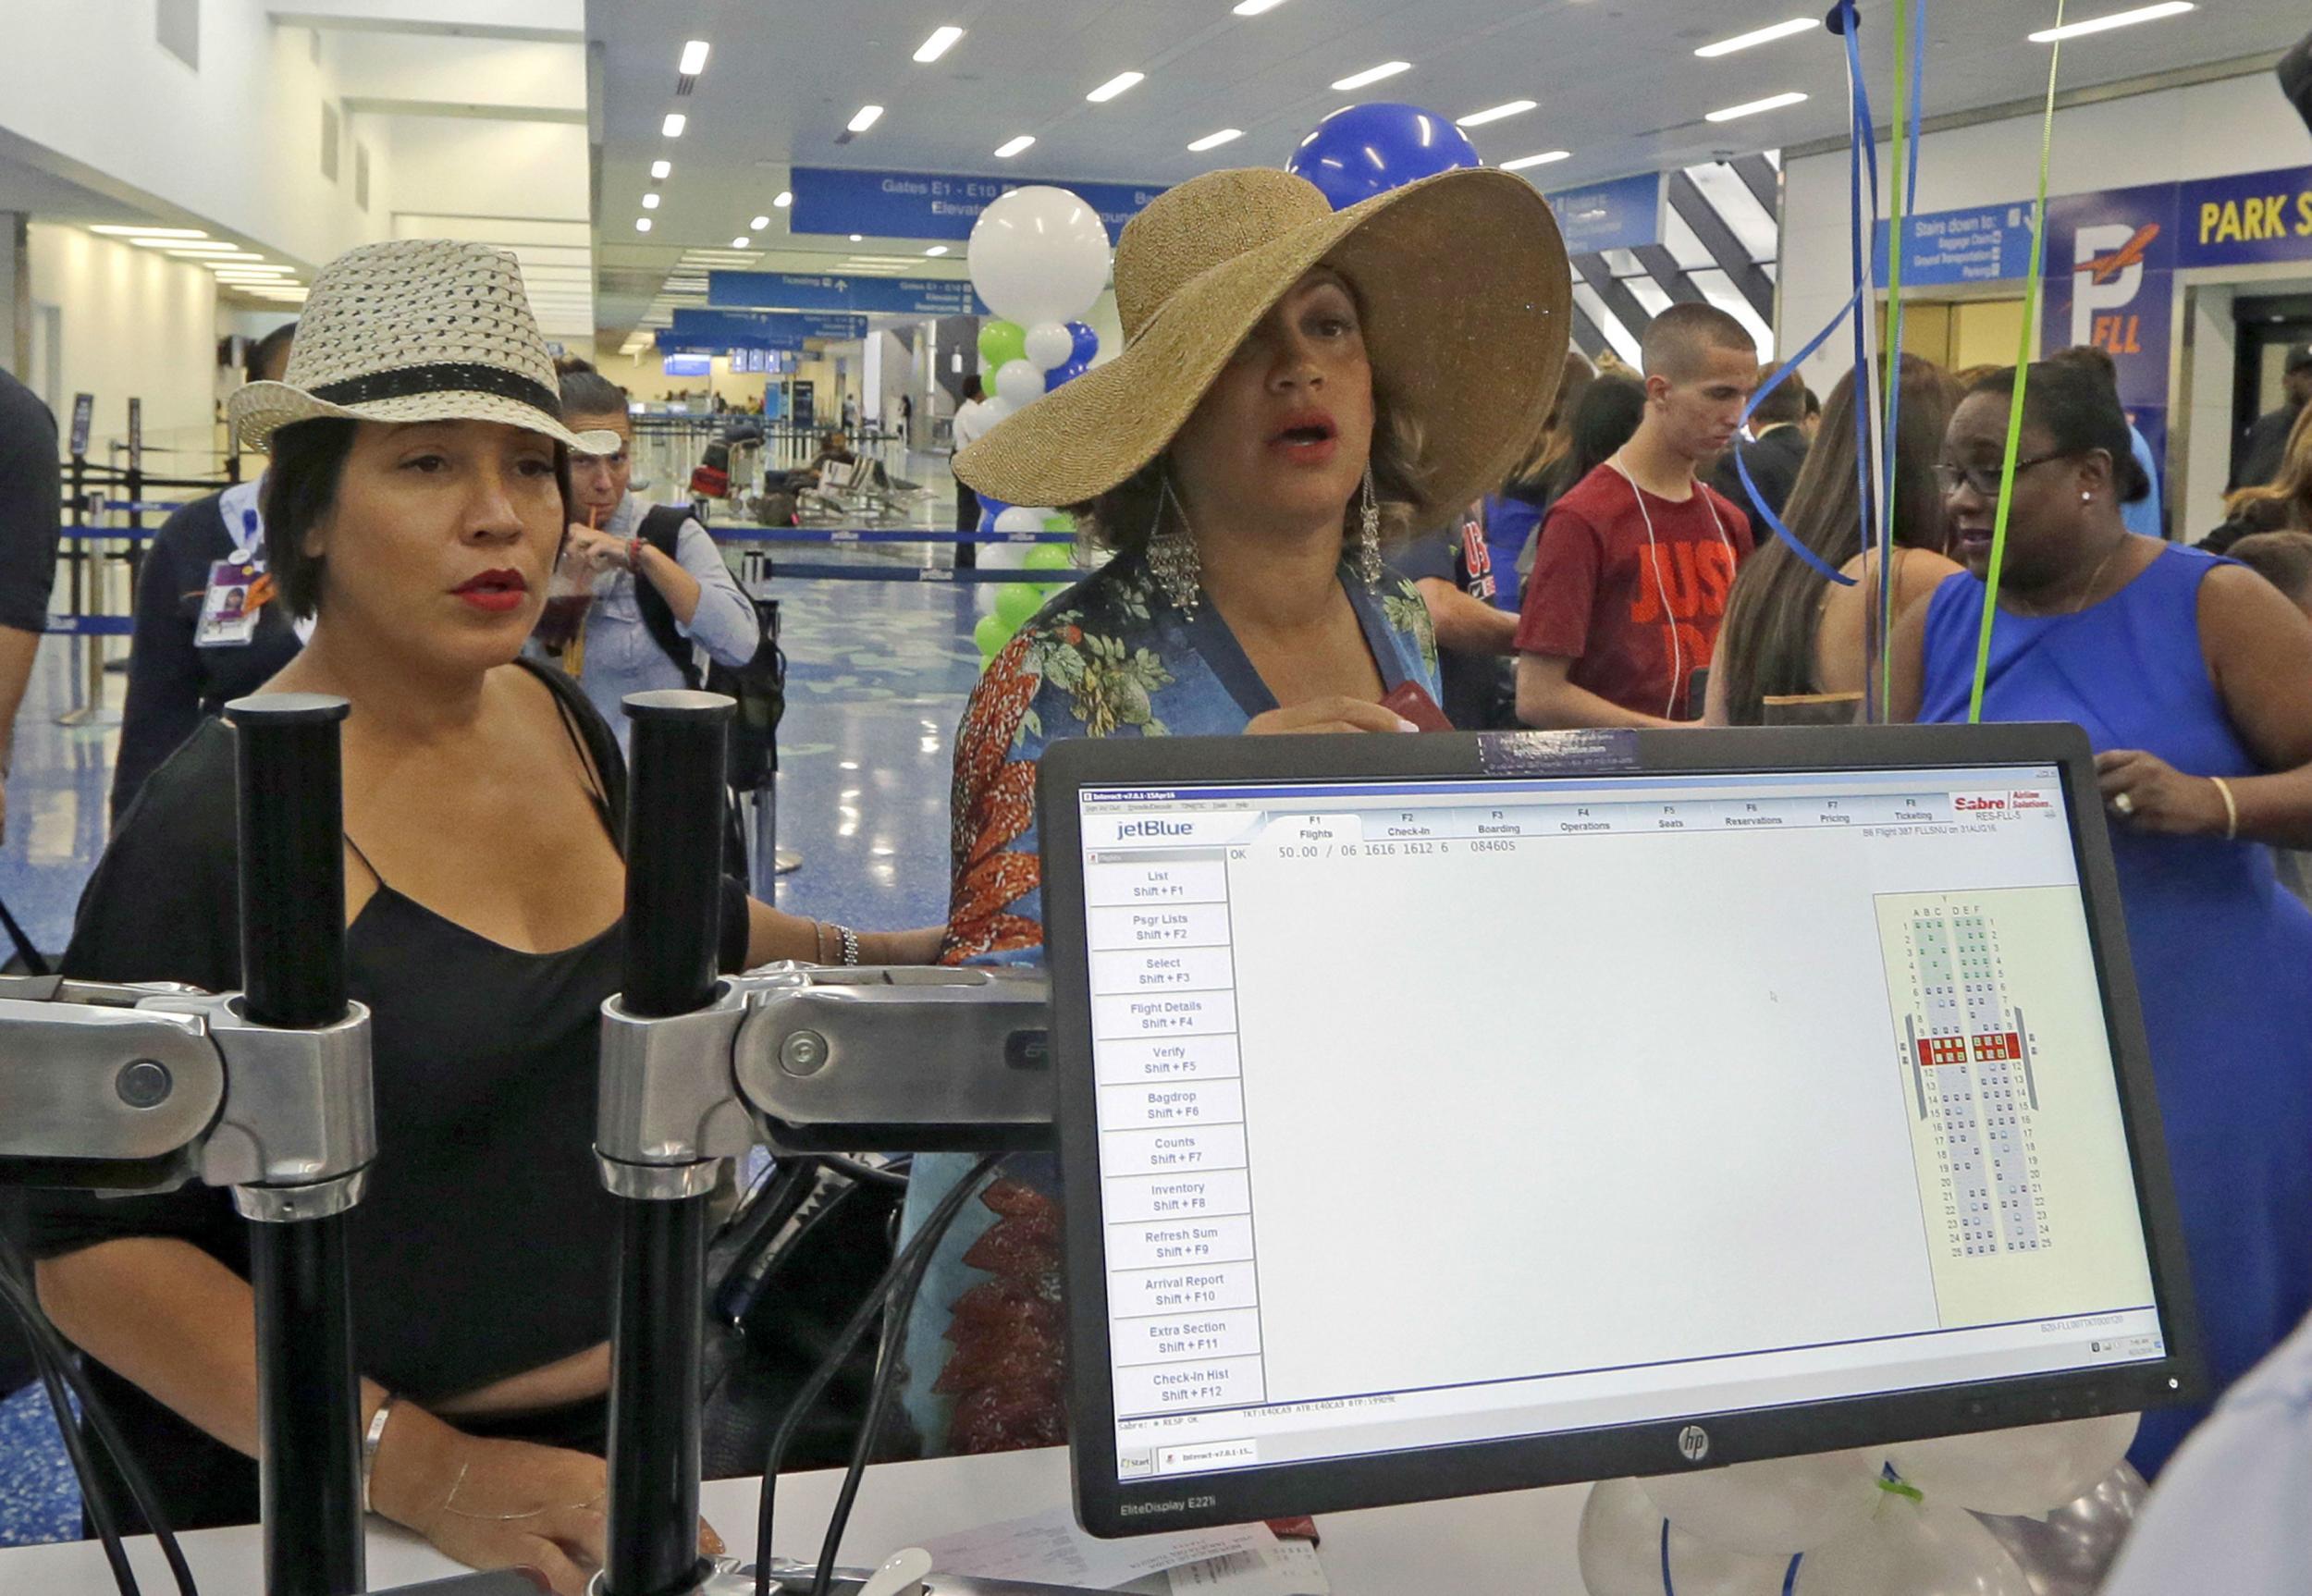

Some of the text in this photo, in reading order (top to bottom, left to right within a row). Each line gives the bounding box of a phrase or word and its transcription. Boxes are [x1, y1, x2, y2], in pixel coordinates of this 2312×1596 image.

[881, 179, 927, 195] Gates
[931, 181, 952, 195] E1
[967, 183, 996, 198] E10
[931, 201, 987, 216] Elevat
[2198, 190, 2312, 245] PARK S
[1915, 215, 1998, 238] Stairs down to:
[2092, 314, 2142, 353] FLL
[2012, 791, 2039, 799] Airline
[1827, 801, 1839, 810] F7
[1954, 796, 2005, 811] Sabre
[1492, 811, 1504, 820] F3
[1578, 808, 1590, 817] F4
[1664, 805, 1676, 815] F5
[1309, 816, 1321, 825] F1
[1402, 813, 1414, 822] F2
[1725, 816, 1782, 827] Reservations
[1819, 814, 1850, 826] Pricing
[1895, 811, 1933, 822] Ticketing
[1478, 824, 1520, 835] Boarding
[1560, 820, 1610, 832] Operations
[1658, 818, 1684, 829] Seats
[1116, 819, 1194, 841] jetBlue
[1299, 829, 1334, 841] Flights
[1387, 827, 1431, 837] Check-In
[1875, 828, 1898, 838] Flight
[1230, 850, 1247, 860] OK
[1279, 845, 1318, 858] 50.00
[1341, 844, 1357, 856] 06
[1364, 843, 1396, 855] 1616
[1403, 842, 1433, 854] 1612
[1441, 841, 1449, 853] 6
[1148, 871, 1168, 881] List
[1133, 887, 1159, 897] Shift
[1170, 886, 1184, 896] F1
[1133, 914, 1188, 927] Psgr Lists
[1136, 930, 1162, 940] Shift
[1174, 929, 1187, 939] F2
[1146, 958, 1181, 968] Select
[1138, 974, 1164, 985] Shift
[1176, 973, 1190, 983] F3
[1130, 1001, 1202, 1015] Flight Details
[1142, 1018, 1167, 1029] Shift
[1179, 1017, 1193, 1027] F4
[1152, 1047, 1186, 1058] Verify
[1144, 1063, 1170, 1074] Shift
[1182, 1062, 1197, 1072] F5
[1148, 1092, 1197, 1105] Bagdrop
[1148, 1108, 1174, 1119] Shift
[1185, 1106, 1199, 1117] F6
[1154, 1137, 1196, 1148] Counts
[1150, 1154, 1176, 1165] Shift
[1188, 1152, 1202, 1162] F7
[1151, 1183, 1205, 1195] Inventory
[1153, 1200, 1179, 1211] Shift
[1191, 1197, 1206, 1209] F8
[1145, 1229, 1218, 1243] Refresh Sum
[1156, 1246, 1182, 1258] Shift
[1195, 1244, 1209, 1255] F9
[1145, 1274, 1224, 1290] Arrival Report
[1155, 1295, 1182, 1306] Shift
[1194, 1291, 1215, 1303] F10
[1150, 1321, 1226, 1338] Extra Section
[1159, 1342, 1185, 1354] Shift
[1198, 1338, 1219, 1350] F11
[1153, 1369, 1229, 1385] Check-In Hist
[1161, 1390, 1188, 1402] Shift
[1200, 1386, 1223, 1398] F12
[1131, 1458, 1150, 1467] Start
[1119, 1500, 1186, 1516] EliteDisplay
